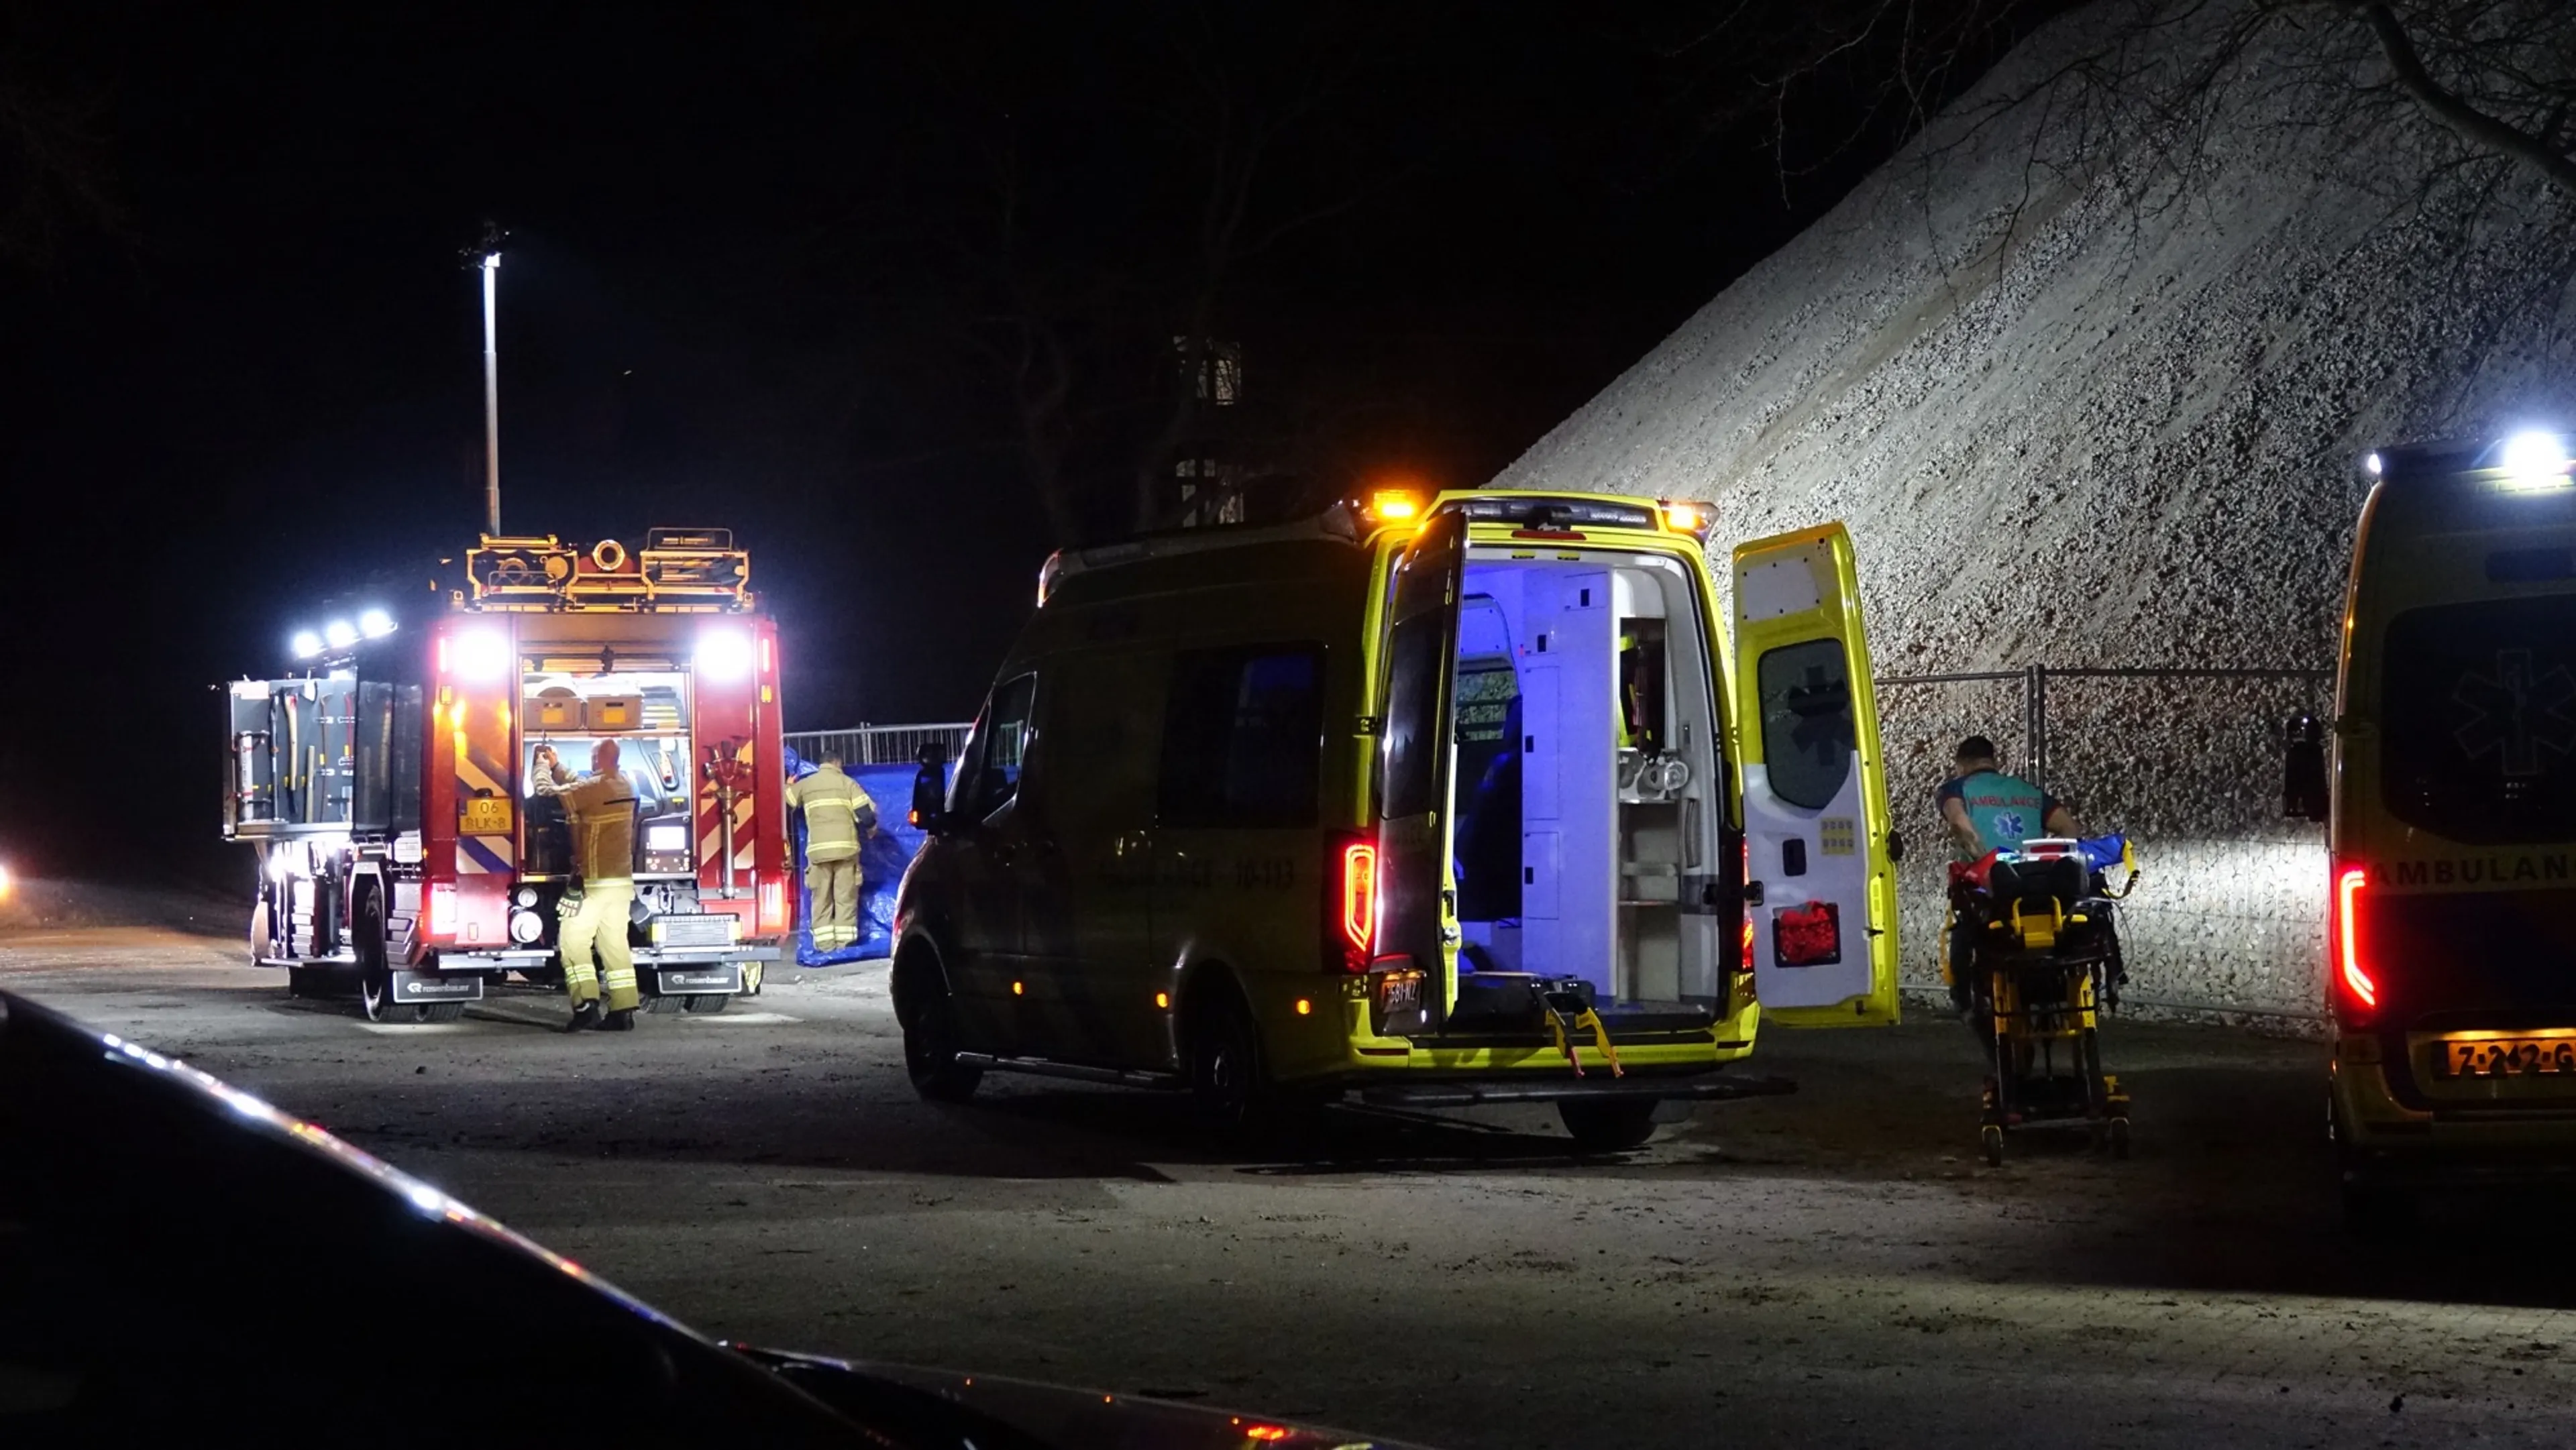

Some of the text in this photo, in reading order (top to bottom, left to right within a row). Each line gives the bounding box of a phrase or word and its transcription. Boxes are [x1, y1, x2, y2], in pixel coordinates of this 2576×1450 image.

[480, 802, 498, 814] 06
[1971, 795, 2041, 809] AMBULANCE
[2370, 854, 2576, 887] AMBULAN
